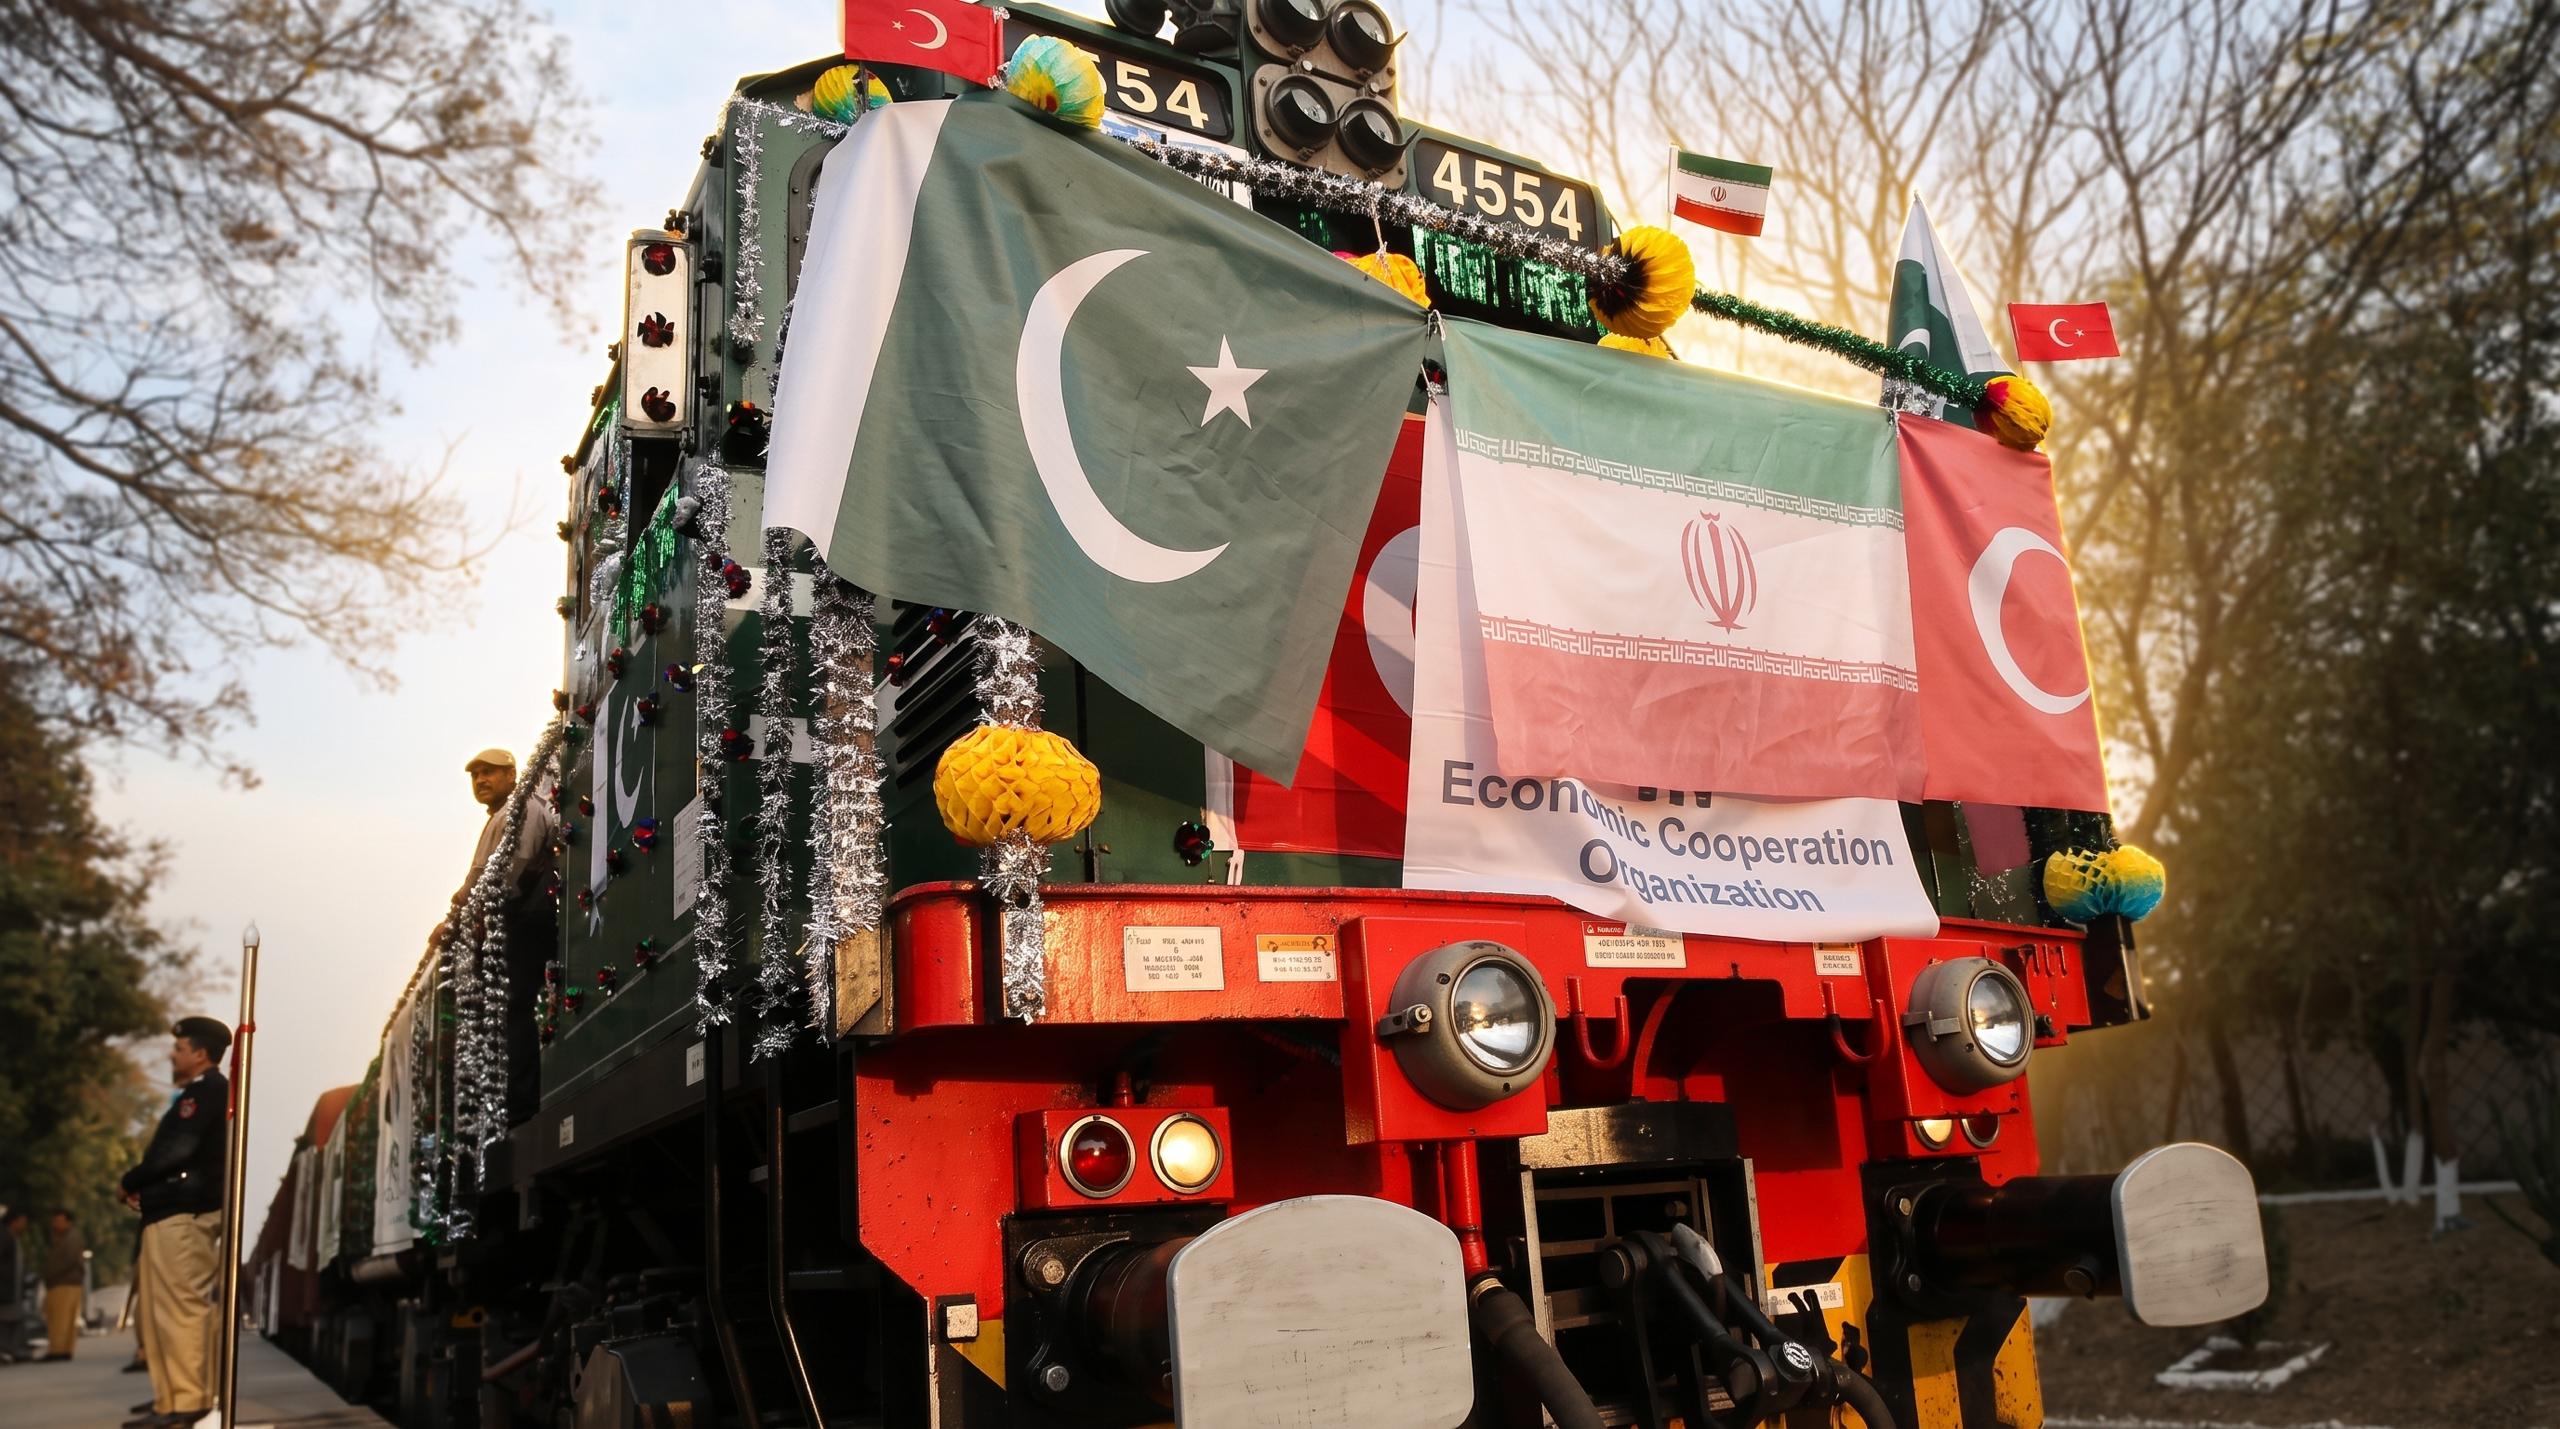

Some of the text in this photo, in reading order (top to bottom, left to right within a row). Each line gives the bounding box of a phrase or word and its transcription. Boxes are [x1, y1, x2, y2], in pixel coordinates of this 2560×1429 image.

[1433, 150, 1582, 241] 4554
[1442, 760, 1894, 870] Economic Cooperation
[1579, 839, 1826, 912] Organization
